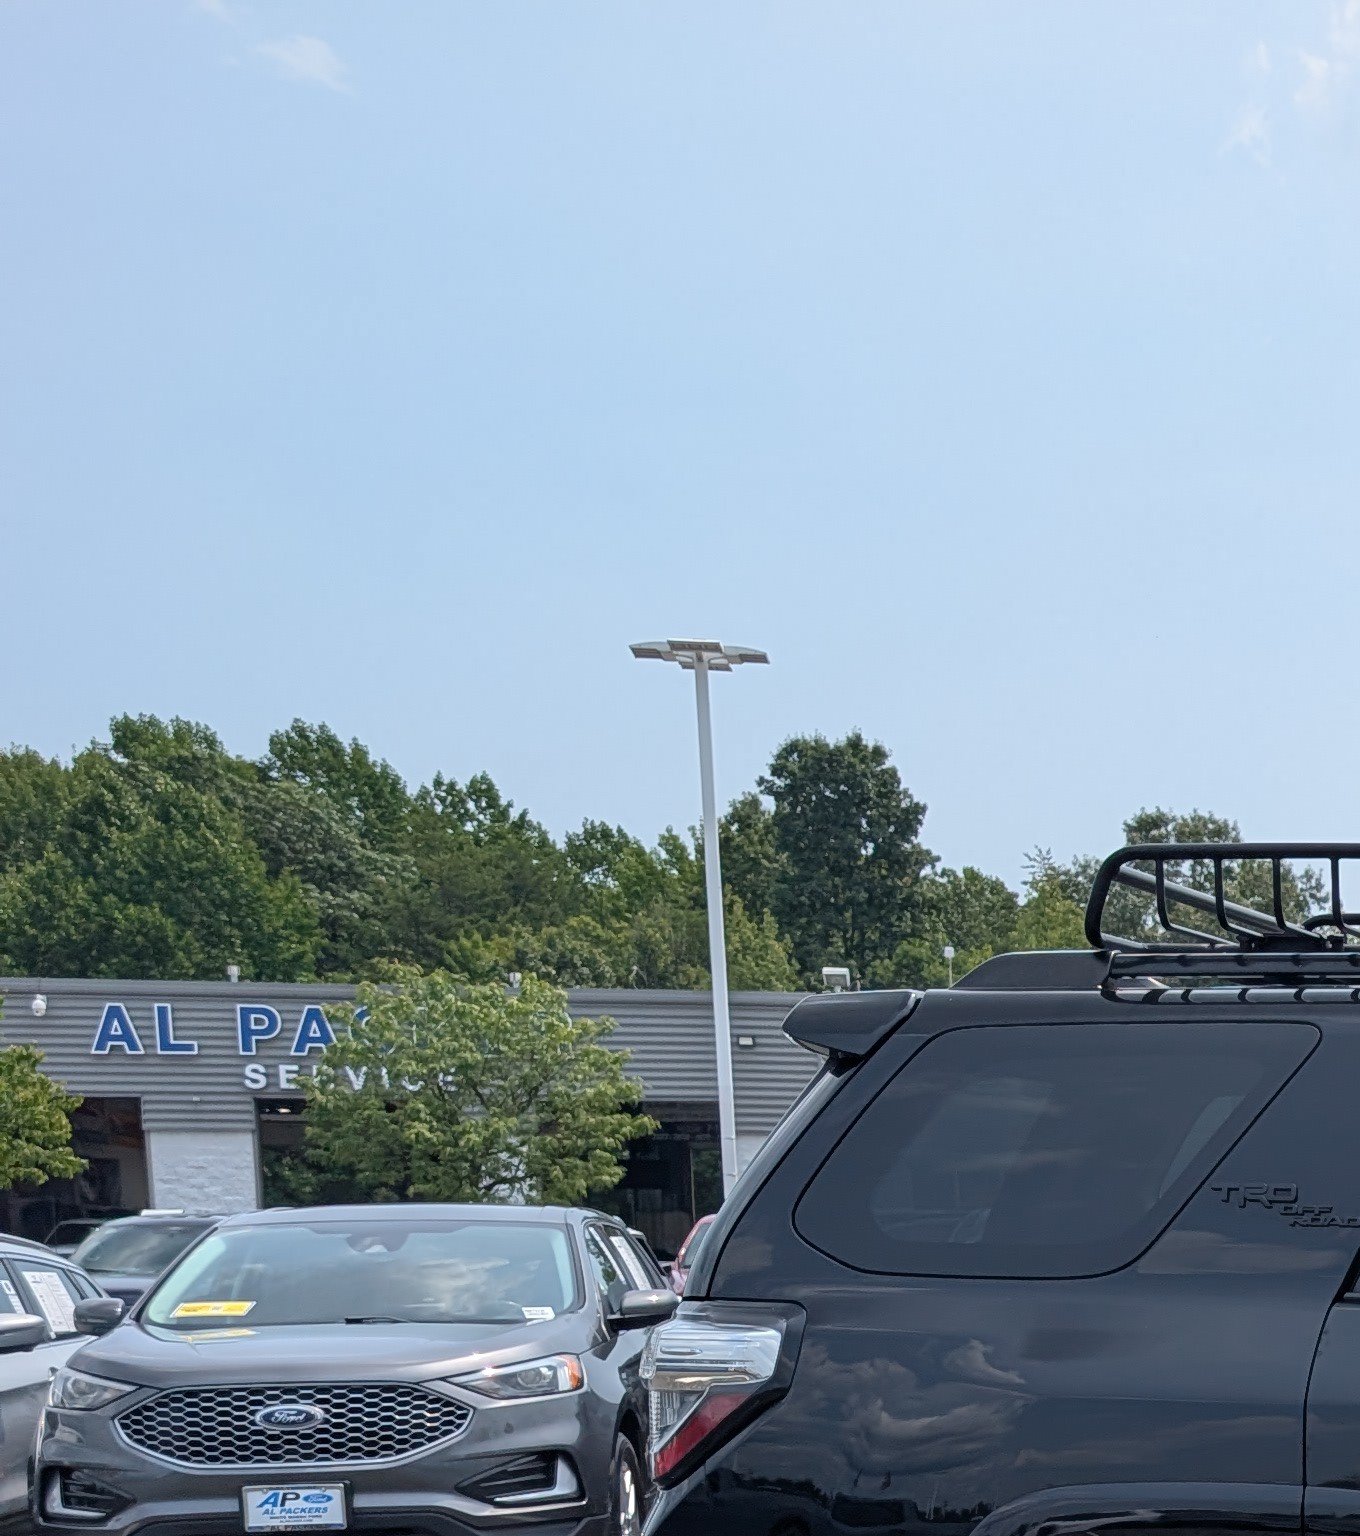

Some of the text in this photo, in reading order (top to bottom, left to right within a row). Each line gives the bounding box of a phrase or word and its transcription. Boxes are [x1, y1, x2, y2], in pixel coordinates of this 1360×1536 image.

[91, 1002, 199, 1056] AL
[1211, 1182, 1299, 1209] TRD
[271, 1410, 307, 1424] Ford
[256, 1491, 301, 1509] AP
[262, 1506, 329, 1516] AL PACKERS
